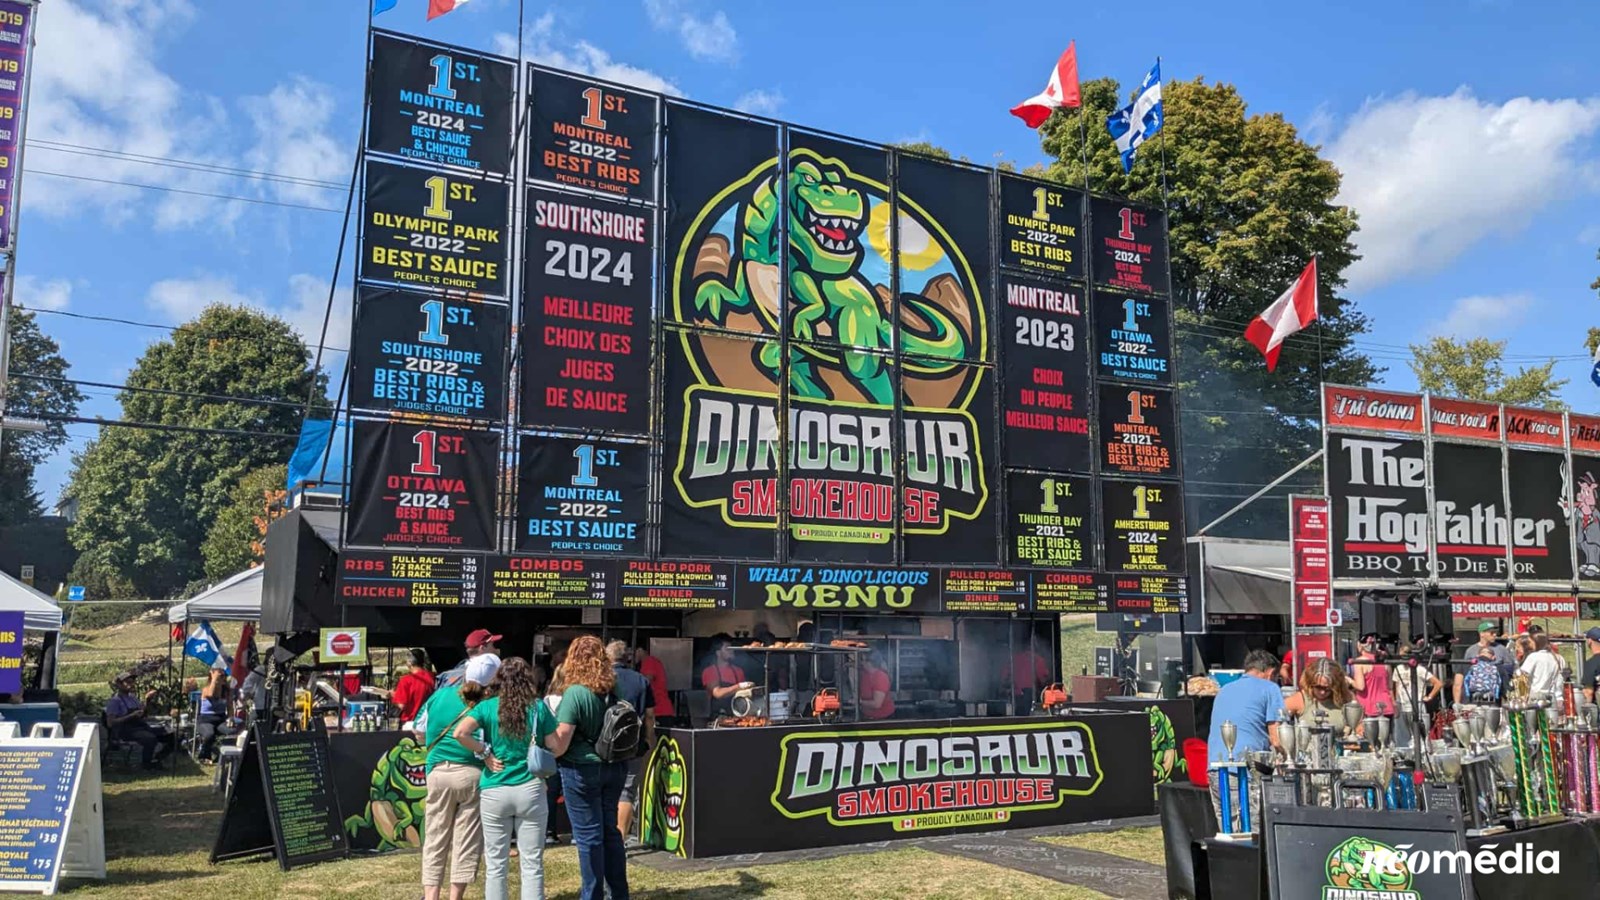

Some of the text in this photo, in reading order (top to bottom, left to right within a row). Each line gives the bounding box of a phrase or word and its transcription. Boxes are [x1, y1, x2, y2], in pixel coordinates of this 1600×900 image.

[400, 90, 484, 117] MONTREAL
[416, 111, 465, 131] 2024
[411, 125, 472, 146] BEST SAUCE
[554, 122, 631, 149] MONTREAL
[569, 141, 616, 161] 2022
[544, 151, 640, 184] BEST RIBS
[374, 212, 499, 243] OLYMPIC PARK
[536, 201, 645, 243] SOUTHSHORE
[1008, 215, 1075, 237] OLYMPIC PARK
[411, 234, 464, 253] 2022
[1027, 230, 1057, 245] 2022
[1011, 240, 1072, 262] BEST RIBS
[1115, 250, 1140, 264] 2024
[372, 247, 497, 279] BEST SAUCE
[545, 240, 633, 286] 2024
[394, 271, 477, 288] PEOPLE'S CHOICE
[1008, 284, 1080, 315] MONTREAL
[544, 296, 633, 325] MEILLEURE
[544, 327, 631, 354] CHOIX DES
[1016, 316, 1074, 351] 2023
[1111, 330, 1152, 343] OTTAWA
[382, 341, 482, 365] SOUTHSHORE
[1118, 342, 1147, 355] 2022
[405, 357, 458, 376] 2022
[560, 359, 614, 382] JUGES
[1101, 352, 1167, 372] BEST SAUCE
[375, 369, 485, 393] BEST RIBS &
[1033, 368, 1063, 386] CHOIX
[373, 384, 484, 408] BEST SAUCE
[546, 387, 627, 413] DE SAUCE
[1021, 390, 1072, 410] DU PEUPLE
[1367, 400, 1415, 420] GONNA
[1006, 411, 1088, 434] MEILLEUR SAUCE
[1114, 424, 1160, 436] MONTREAL
[1432, 408, 1456, 424] MAKE
[1460, 413, 1478, 427] YOU
[1479, 416, 1487, 428] A
[1532, 422, 1544, 434] YOU
[689, 398, 975, 495] DINOSAUR
[1123, 434, 1152, 445] 2021
[1108, 443, 1169, 457] BEST RIBS &
[1108, 454, 1170, 468] BEST SAUCE
[1341, 438, 1426, 488] The
[387, 476, 466, 493] OTTAWA
[544, 486, 622, 502] MONTREAL
[400, 492, 449, 508] 2024
[732, 477, 940, 524] SMOKEHOUSE
[396, 506, 454, 521] BEST RIBS
[560, 503, 608, 518] 2022
[1018, 514, 1082, 526] THUNDER BAY
[529, 518, 636, 539] BEST SAUCE
[811, 529, 871, 539] PROUDLY CANADIAN
[1036, 526, 1065, 537] 2021
[1114, 520, 1170, 531] AMHERSTBURG
[1344, 496, 1555, 553] Hogfather
[1018, 536, 1081, 549] BEST RIBS &
[1128, 533, 1157, 544] 2024
[1018, 548, 1082, 561] BEST SAUCE
[345, 559, 384, 571] RIBS
[510, 559, 584, 571] COMBOS
[630, 562, 711, 572] PULLED PORK
[1348, 555, 1402, 574] BBQ
[1455, 556, 1488, 573] DIE
[749, 567, 800, 582] WHAT
[802, 568, 813, 583] A
[1046, 574, 1092, 584] COMBOS
[343, 586, 406, 597] CHICKEN
[412, 597, 459, 605] QUARTER
[648, 589, 692, 597] DINNER
[765, 584, 915, 608] MENU
[1468, 602, 1510, 613] CHICKEN
[1515, 602, 1549, 612] PULLED
[1551, 603, 1575, 612] PORK
[787, 730, 1091, 800] DINOSAUR
[838, 778, 1055, 818] SMOKEHOUSE
[916, 811, 994, 827] PROUDLY CANADIAN
[40, 833, 58, 843] $38
[34, 858, 52, 868] $75
